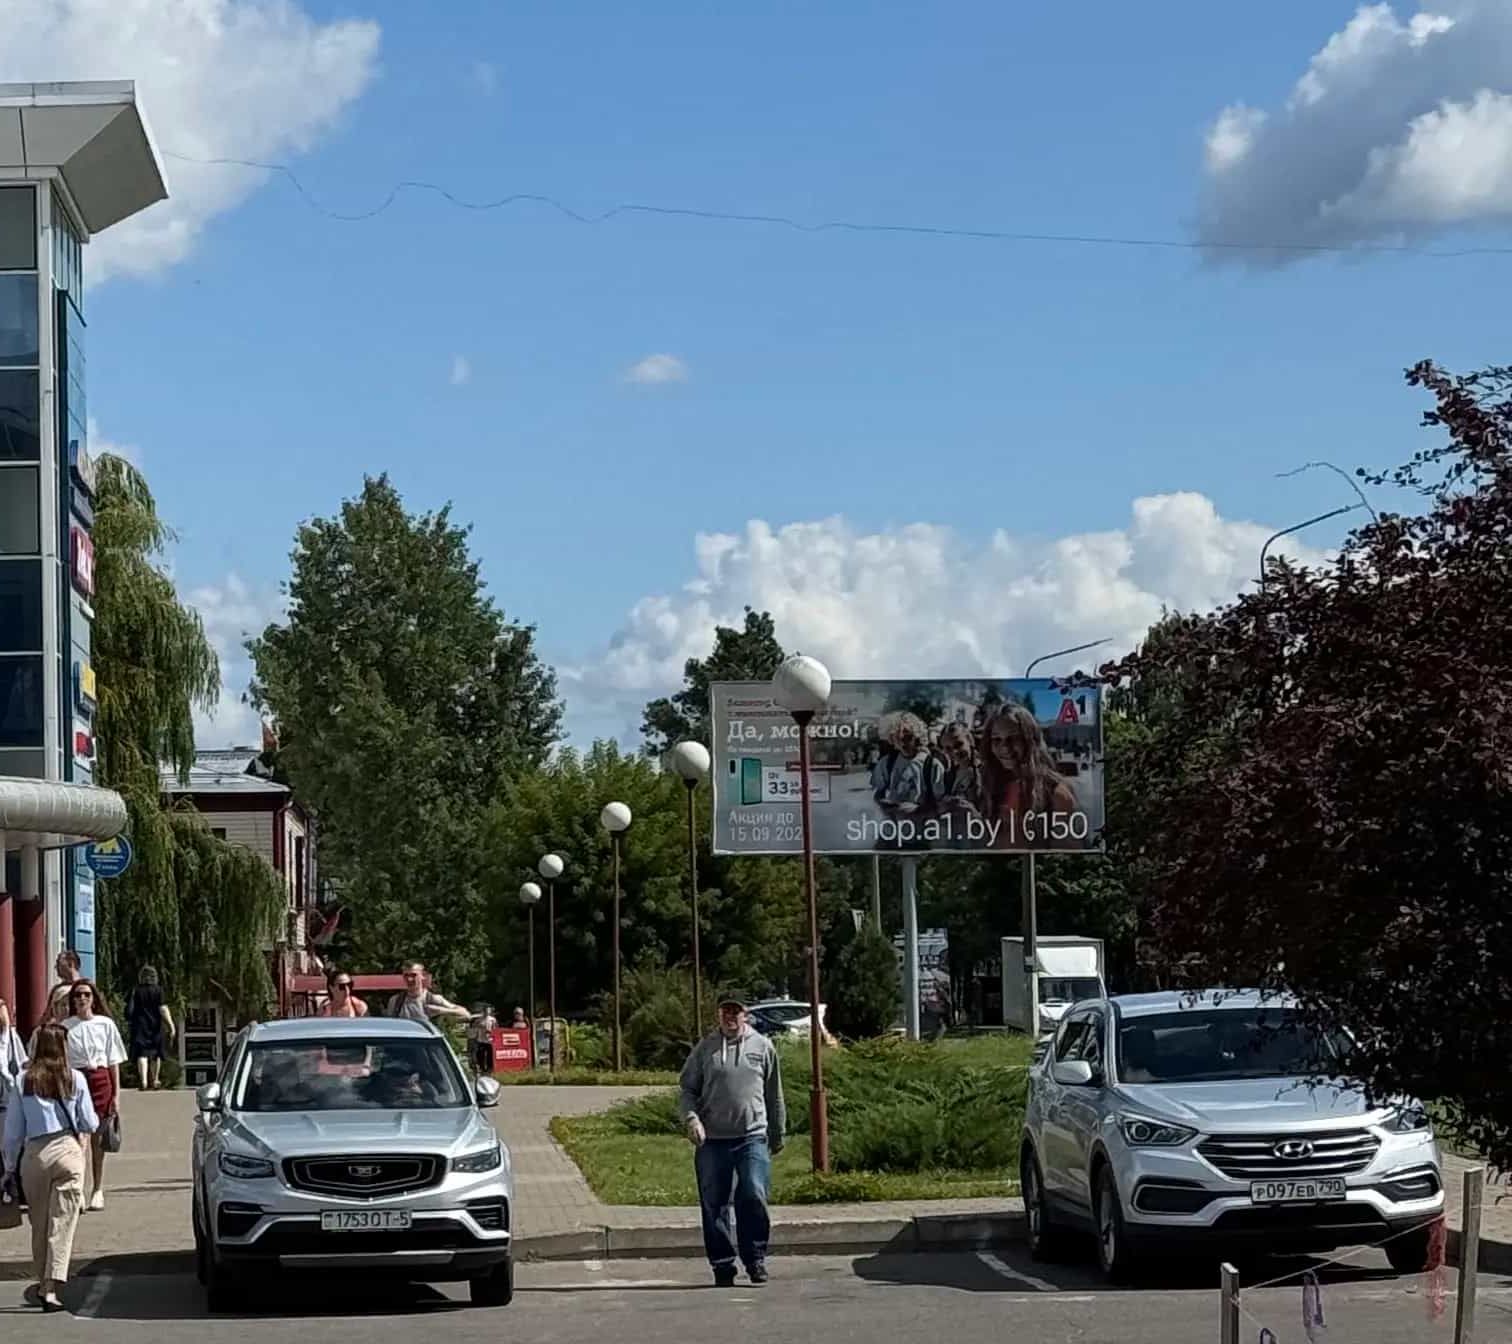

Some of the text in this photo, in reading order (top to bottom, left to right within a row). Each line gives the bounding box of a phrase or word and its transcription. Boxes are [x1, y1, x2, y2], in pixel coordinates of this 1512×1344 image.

[1057, 695, 1086, 724] A1
[728, 720, 764, 743] Да,
[846, 811, 1088, 847] shop.a1.by 150
